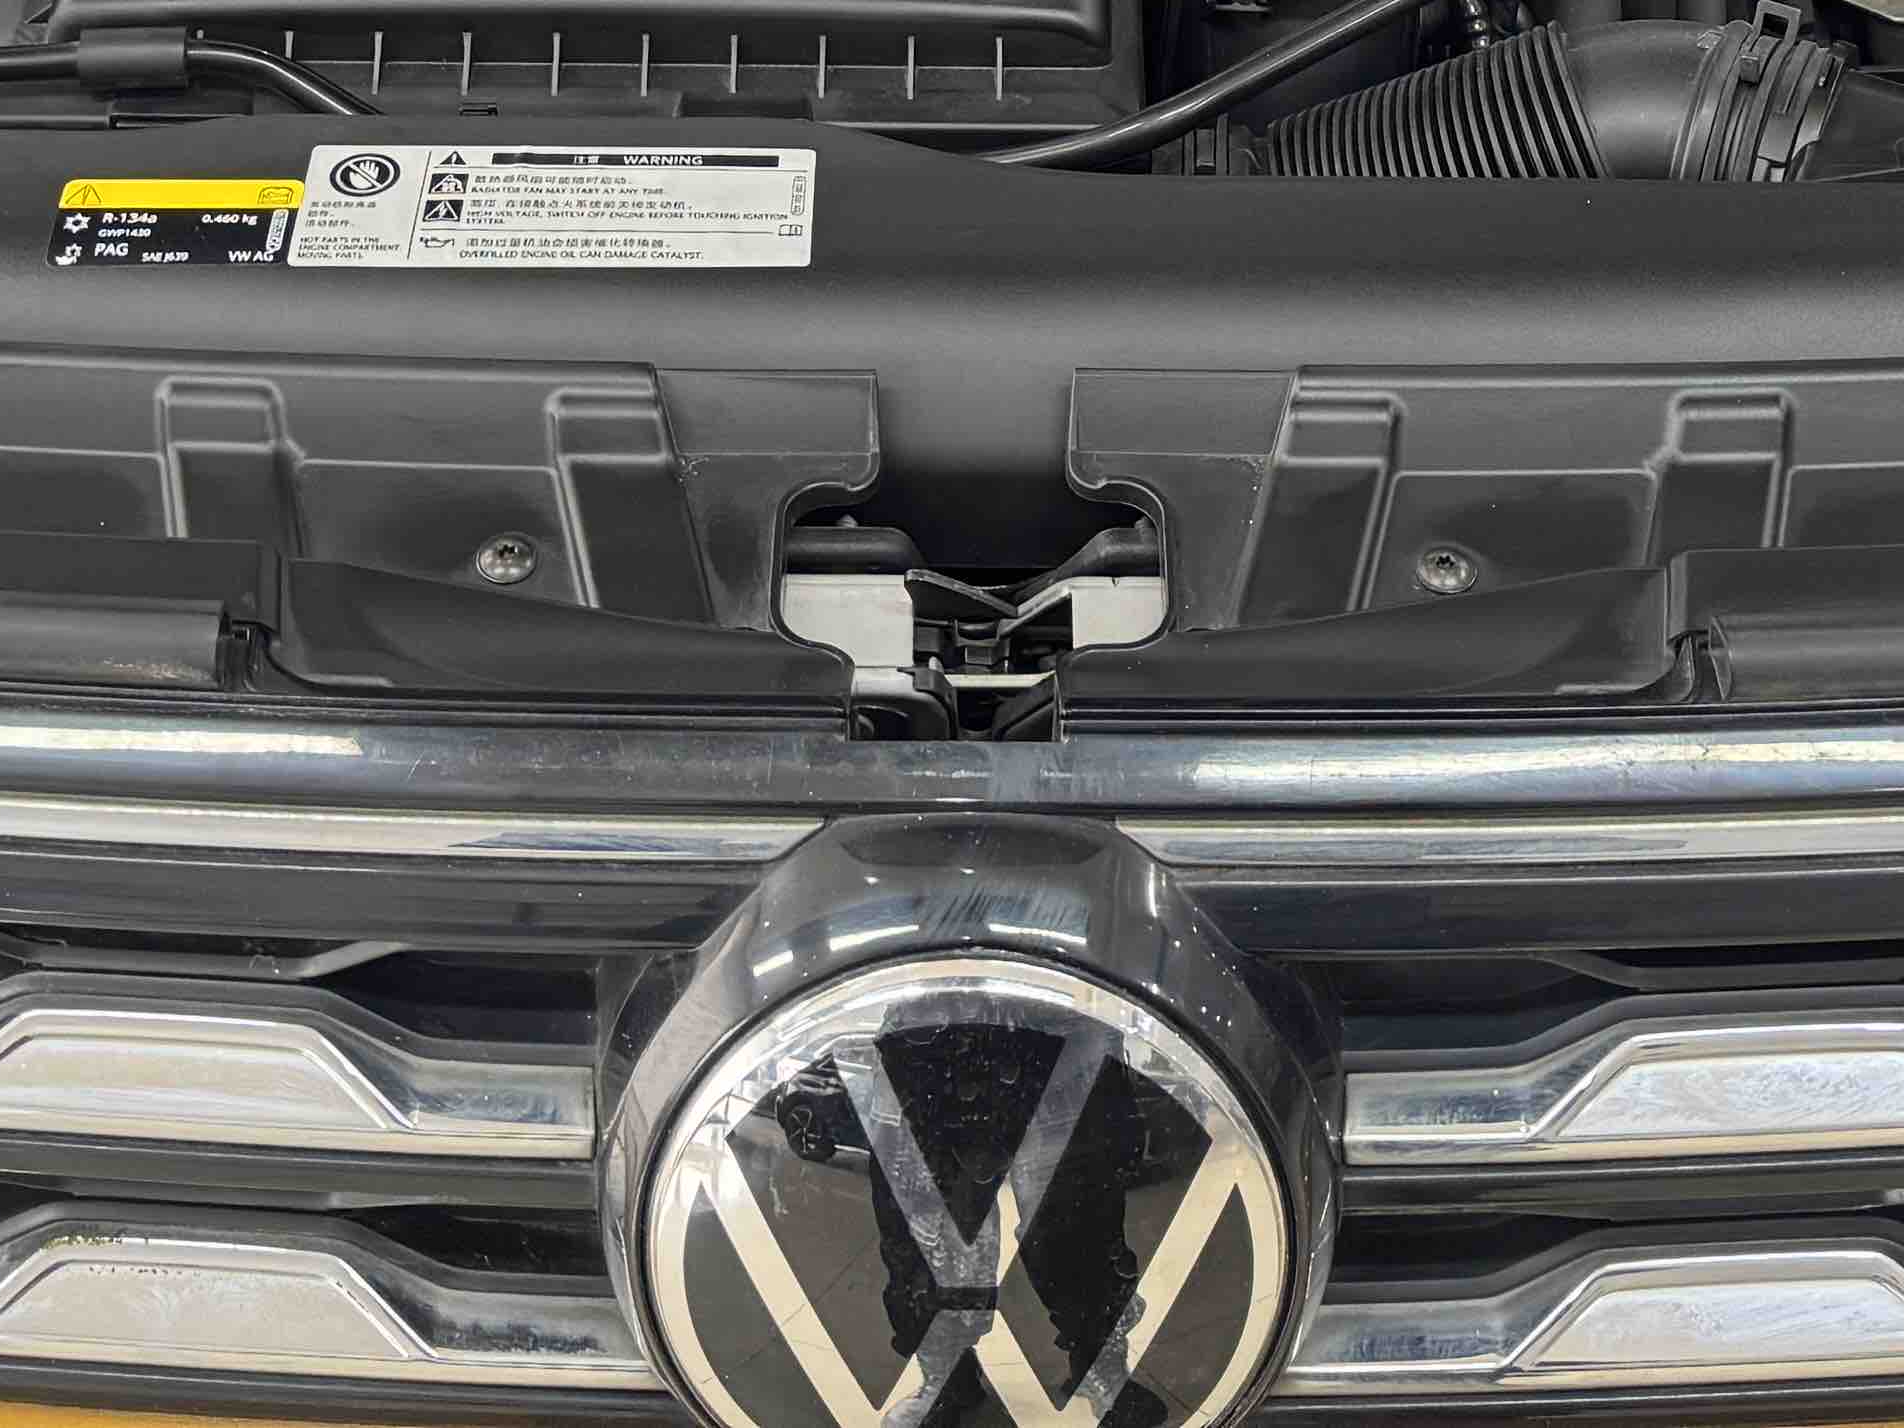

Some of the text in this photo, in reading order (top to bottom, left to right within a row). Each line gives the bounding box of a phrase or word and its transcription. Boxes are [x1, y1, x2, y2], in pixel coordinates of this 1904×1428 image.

[623, 155, 704, 165] WARNING
[101, 212, 158, 225] R-134a
[609, 211, 645, 219] ENGINE
[688, 212, 740, 220] TOUCHING
[743, 213, 788, 221] IGNITION
[322, 236, 349, 244] PARTS
[94, 242, 130, 257] PAG
[228, 250, 253, 263] VW
[459, 250, 518, 259] OVERFILLED
[521, 250, 558, 259] ENGINE
[559, 250, 576, 259] OIL
[579, 250, 601, 259] CAN
[604, 251, 647, 259] DAMAGE
